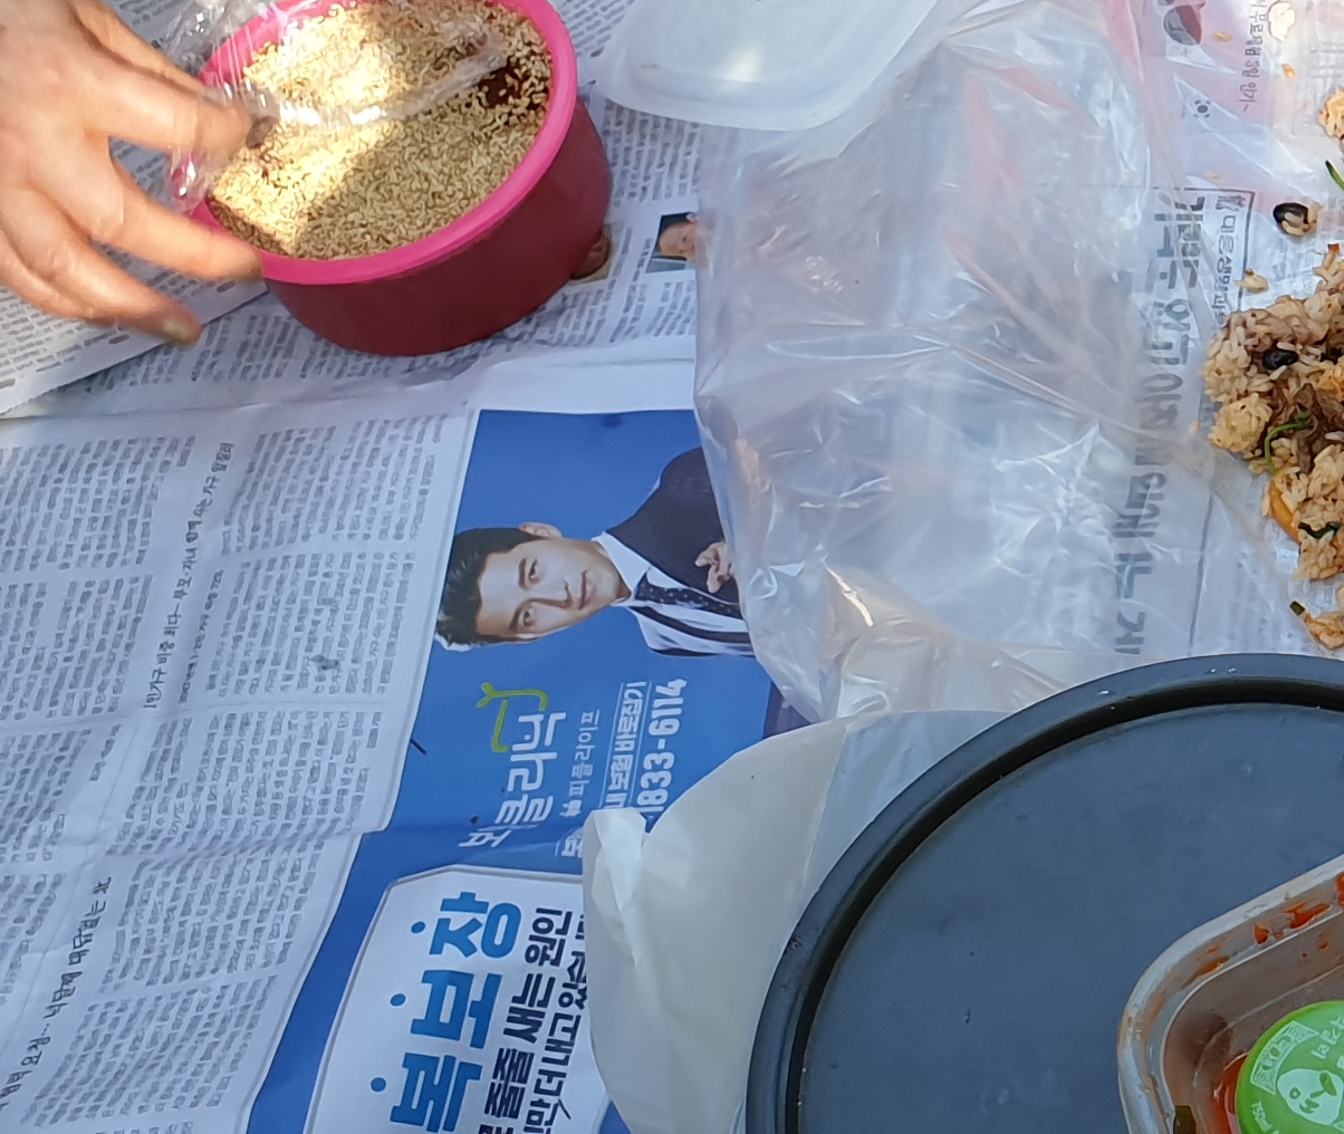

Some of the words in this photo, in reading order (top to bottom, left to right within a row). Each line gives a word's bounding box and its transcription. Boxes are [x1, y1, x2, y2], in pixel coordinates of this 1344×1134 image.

[569, 709, 600, 797] 피플라이프
[609, 755, 634, 790] 보험
[639, 679, 688, 813] 1833-6114
[524, 907, 572, 968] 원인
[390, 891, 523, 1132] 복보장
[503, 971, 554, 1043] 새는
[542, 1011, 581, 1066] 내고
[484, 1046, 533, 1120] 줄줄
[533, 1068, 565, 1096] 더
